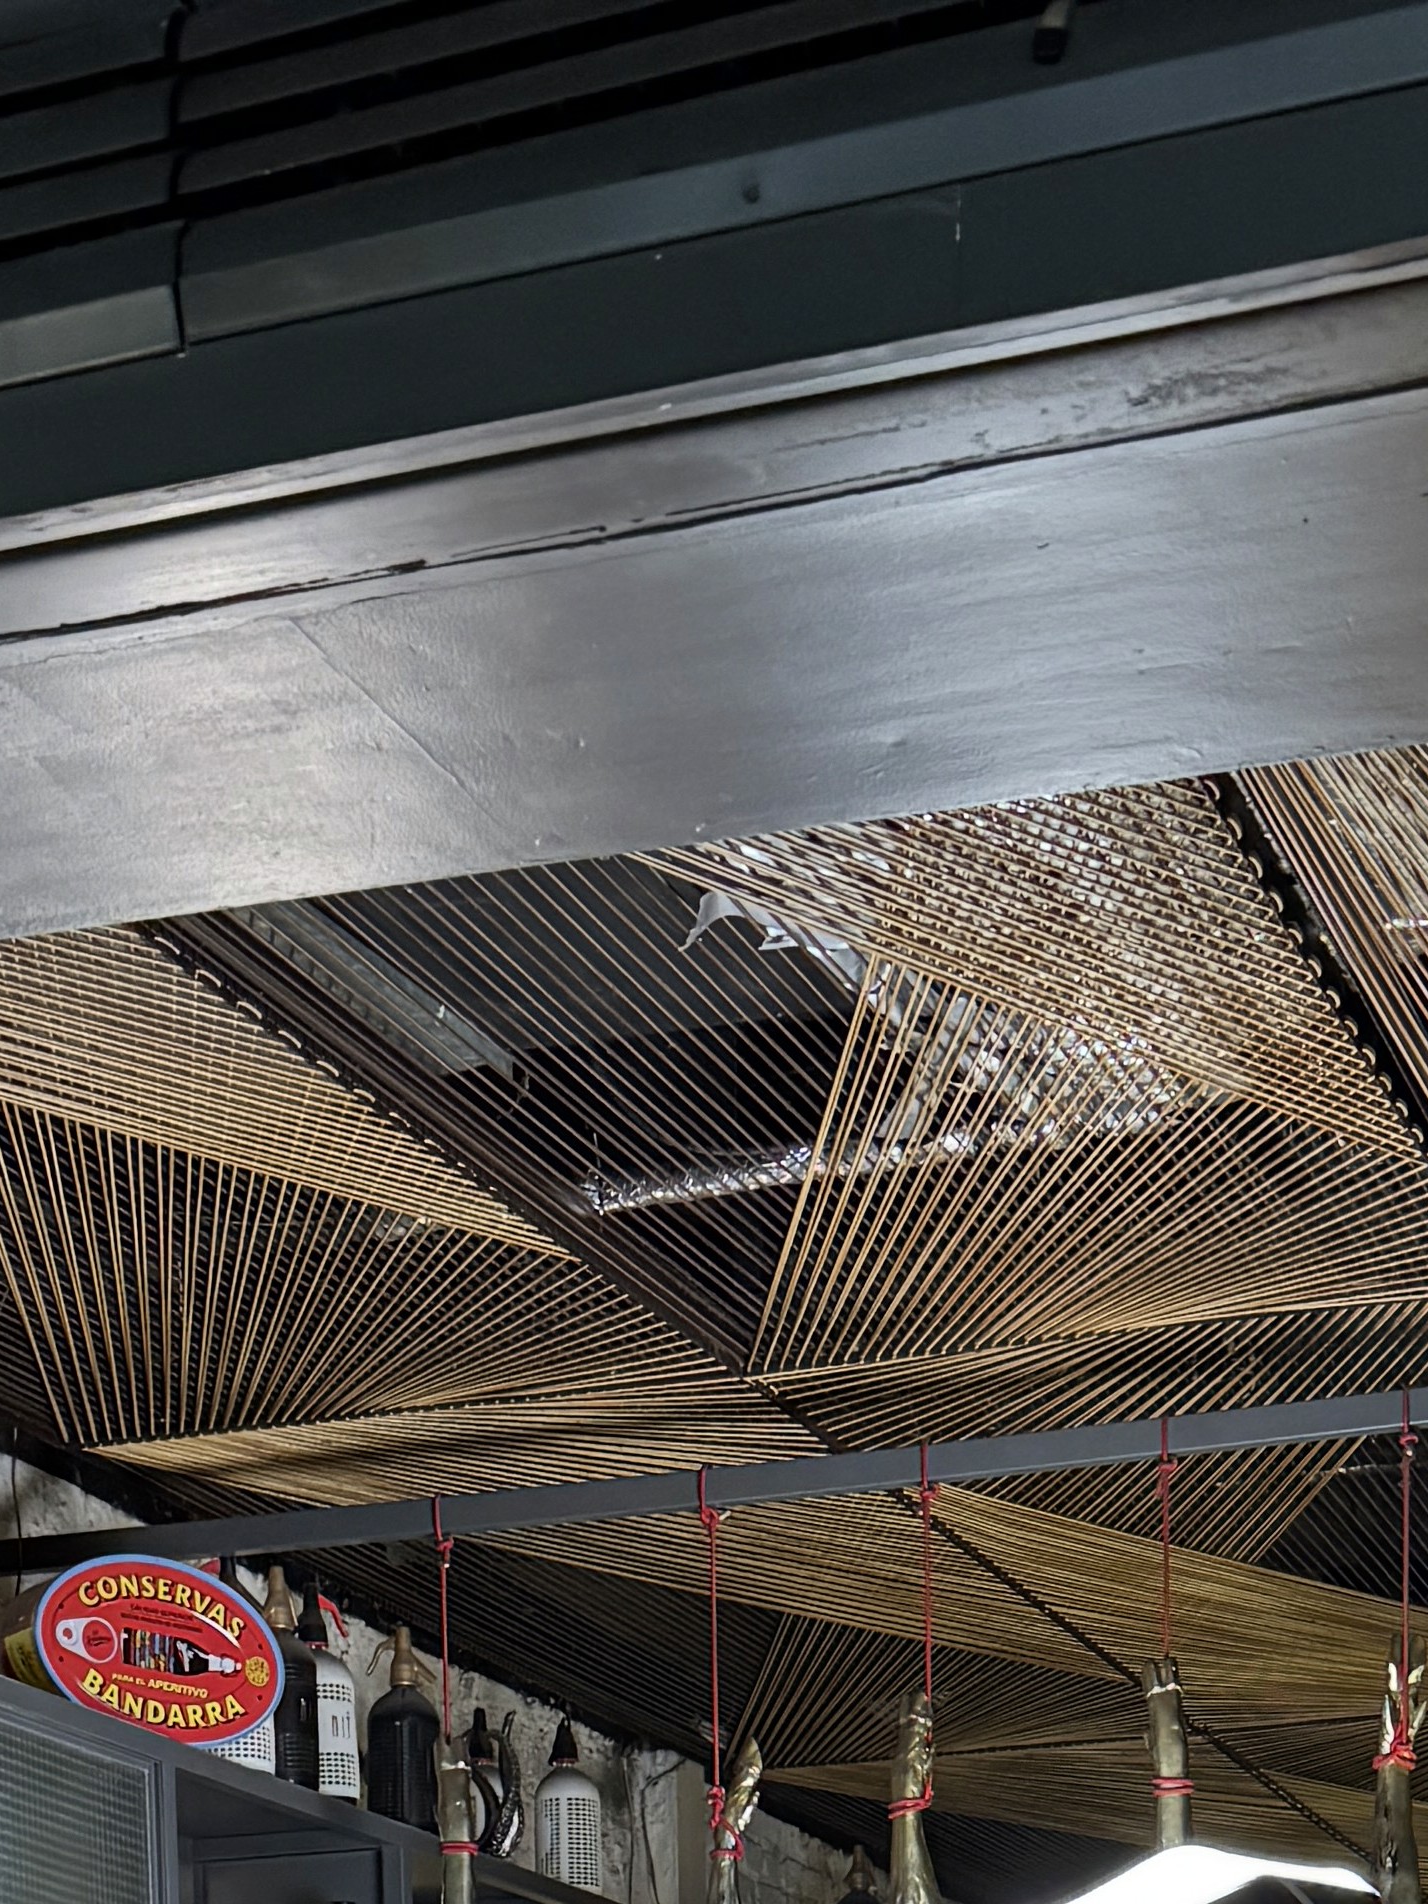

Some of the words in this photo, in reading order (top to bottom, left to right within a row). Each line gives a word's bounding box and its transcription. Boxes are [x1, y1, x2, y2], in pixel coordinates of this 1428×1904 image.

[77, 1573, 246, 1638] CONSERVAS
[81, 1668, 246, 1729] BANDARRA
[147, 1678, 209, 1699] APERITIVO
